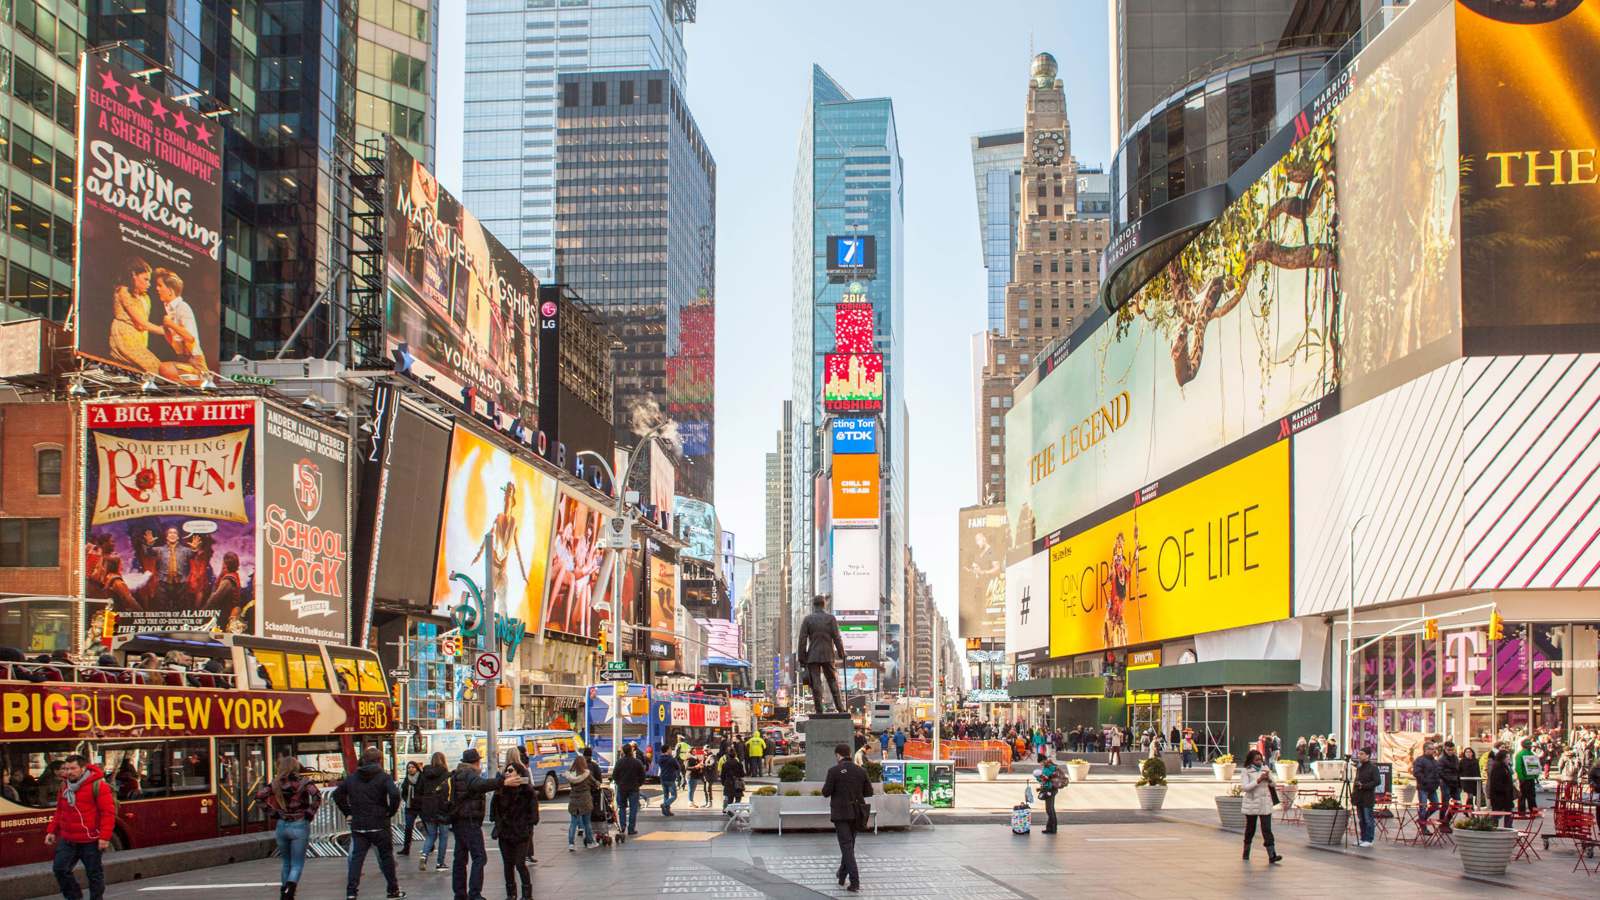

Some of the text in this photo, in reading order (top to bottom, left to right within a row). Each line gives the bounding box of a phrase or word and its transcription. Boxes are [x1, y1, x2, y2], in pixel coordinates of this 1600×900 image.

[1313, 63, 1360, 110] MARRIOTT
[1313, 81, 1355, 124] MARQUIS
[98, 111, 108, 131] A
[111, 115, 151, 153] SHEER
[90, 140, 194, 214] SPRING
[1486, 148, 1600, 189] THE
[86, 176, 222, 261] awakening
[397, 183, 474, 272] MARQUEE
[843, 240, 859, 263] 7
[843, 294, 866, 303] 2016
[542, 320, 556, 329] LG
[233, 374, 272, 386] LAMAR
[443, 343, 502, 394] VORNADO
[159, 404, 197, 421] FAT
[826, 400, 881, 410] TOSHIBA
[116, 439, 227, 457] SOMETHING
[267, 422, 282, 438] HAS
[282, 426, 317, 452] BROADWAY
[298, 422, 319, 441] LLOYD
[319, 432, 345, 452] WEBBER
[1027, 389, 1132, 486] THE LEGEND
[264, 504, 347, 561] SCHOOL
[271, 545, 343, 598] ROCK
[1080, 545, 1148, 613] CIRLE
[1157, 528, 1195, 593] OF
[1207, 503, 1260, 582] LIFE
[180, 609, 221, 618] ALADDIN
[138, 625, 163, 633] BOOK
[144, 696, 211, 731] NEW
[218, 697, 285, 730] YORK
[358, 700, 375, 716] BIG
[359, 715, 376, 729] BUS
[673, 708, 719, 721] OPEN LOOP
[1, 816, 55, 829] BIGBUSTOURS.C
